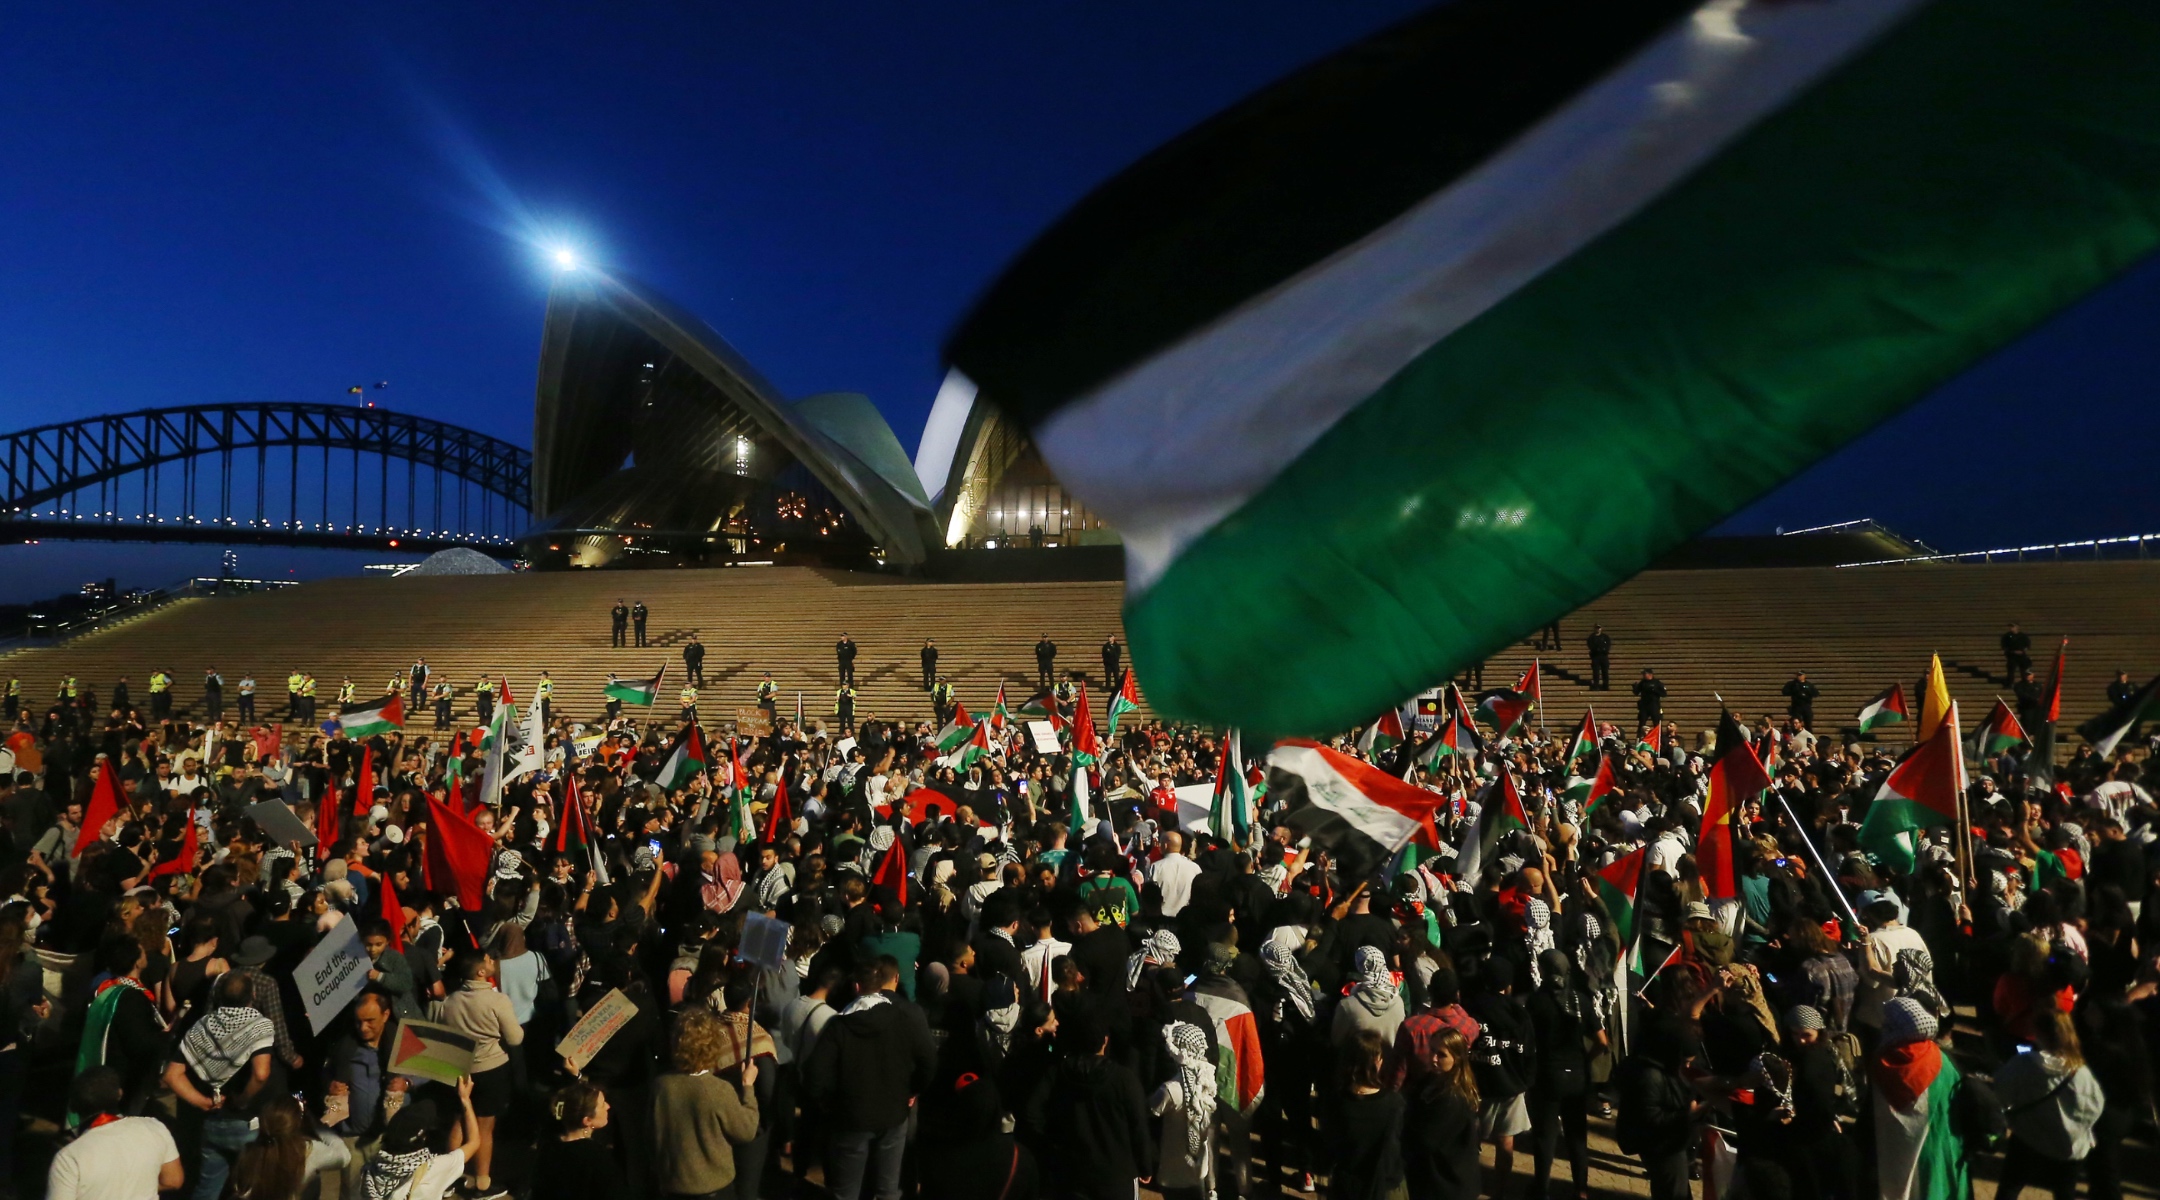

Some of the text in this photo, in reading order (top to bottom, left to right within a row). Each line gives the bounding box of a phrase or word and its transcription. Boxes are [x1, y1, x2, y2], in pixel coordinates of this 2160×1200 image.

[739, 708, 761, 716] BLOCK
[313, 955, 360, 1006] Occupation
[314, 950, 346, 986] End the
